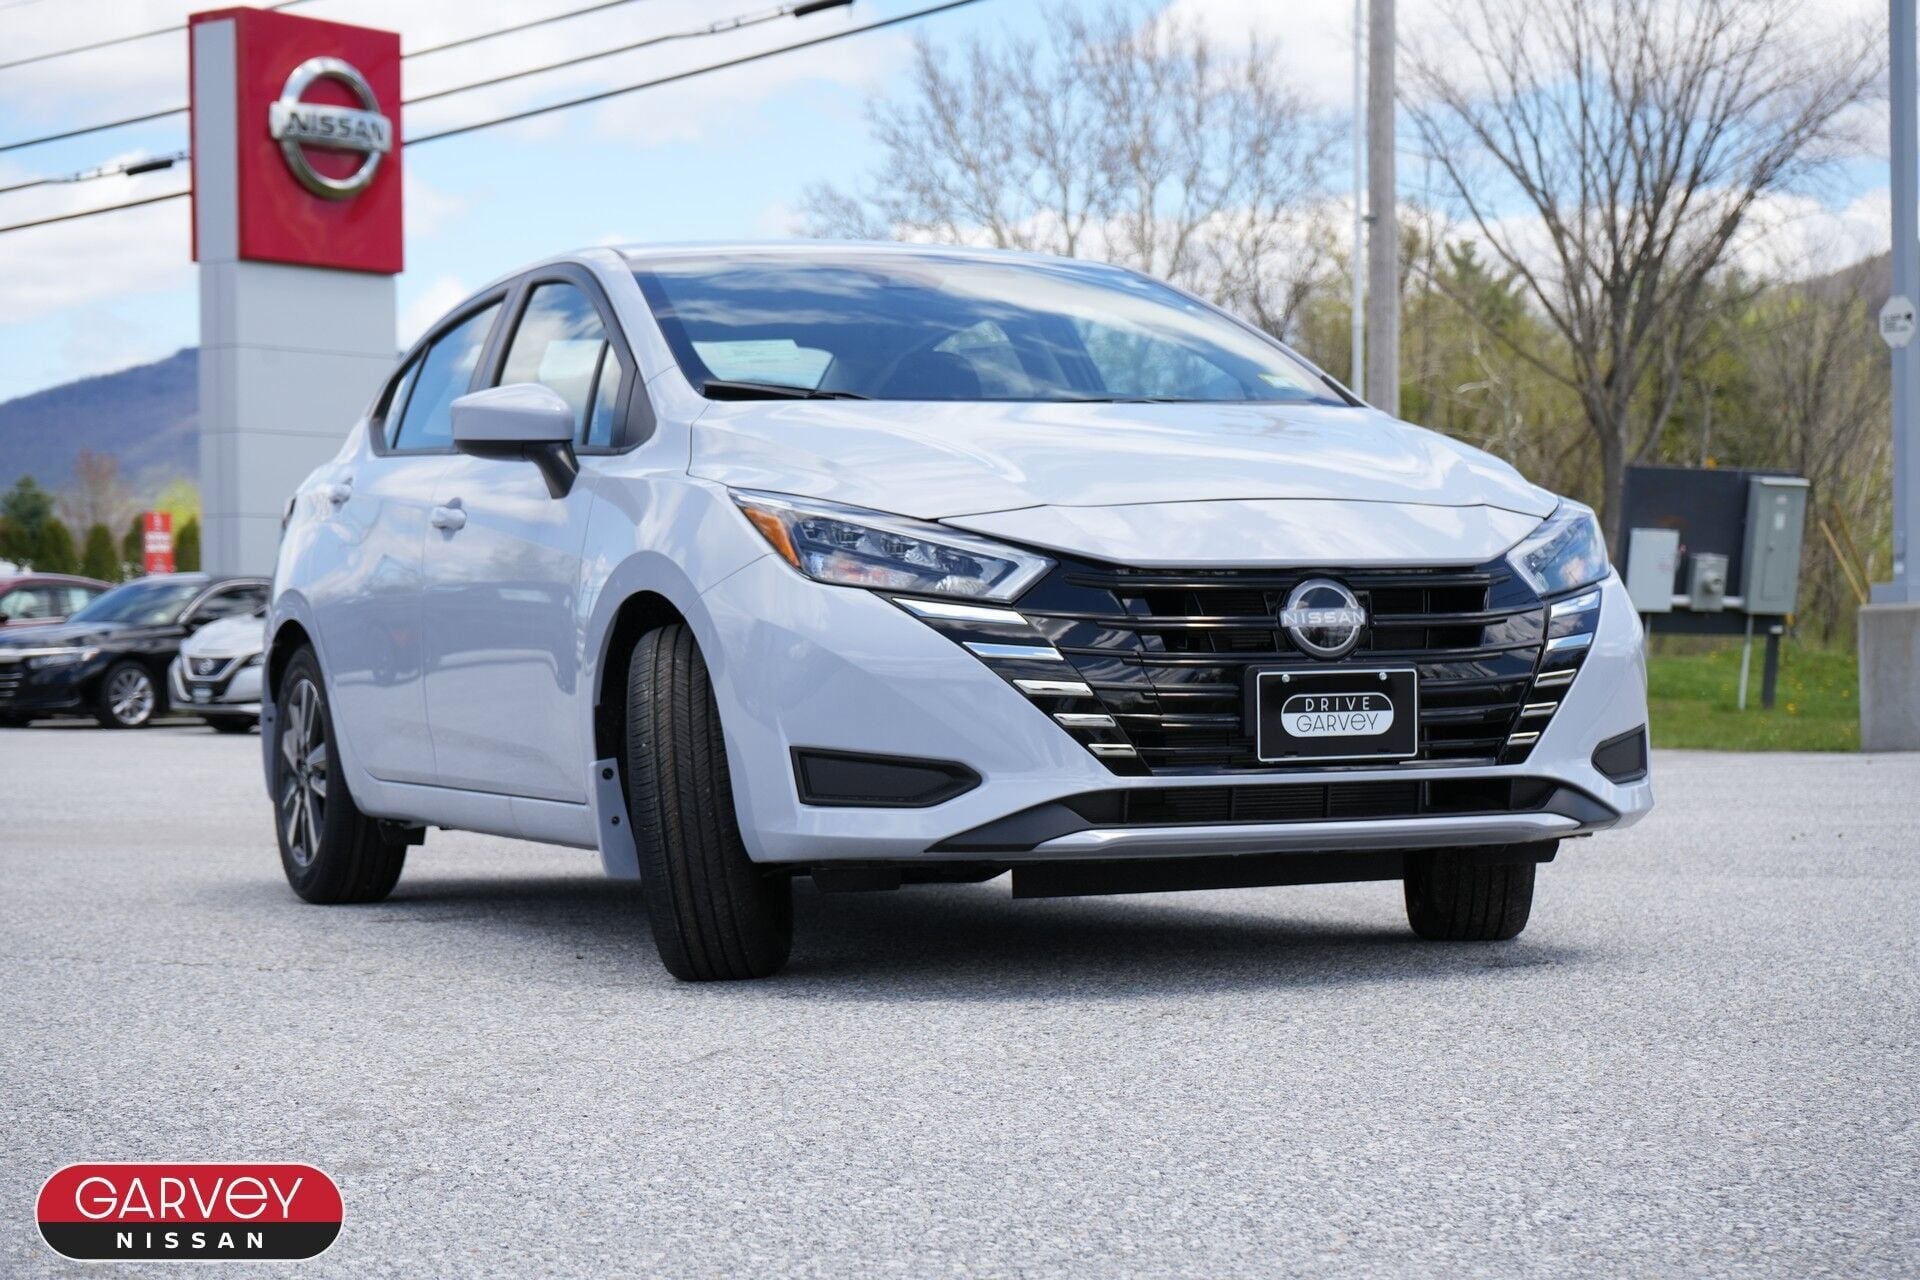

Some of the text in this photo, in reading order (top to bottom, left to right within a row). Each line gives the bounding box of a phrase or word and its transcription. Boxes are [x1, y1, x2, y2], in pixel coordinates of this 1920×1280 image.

[285, 112, 384, 142] NISSAN
[1283, 611, 1365, 626] NISSAN
[1305, 696, 1370, 712] DRIVE
